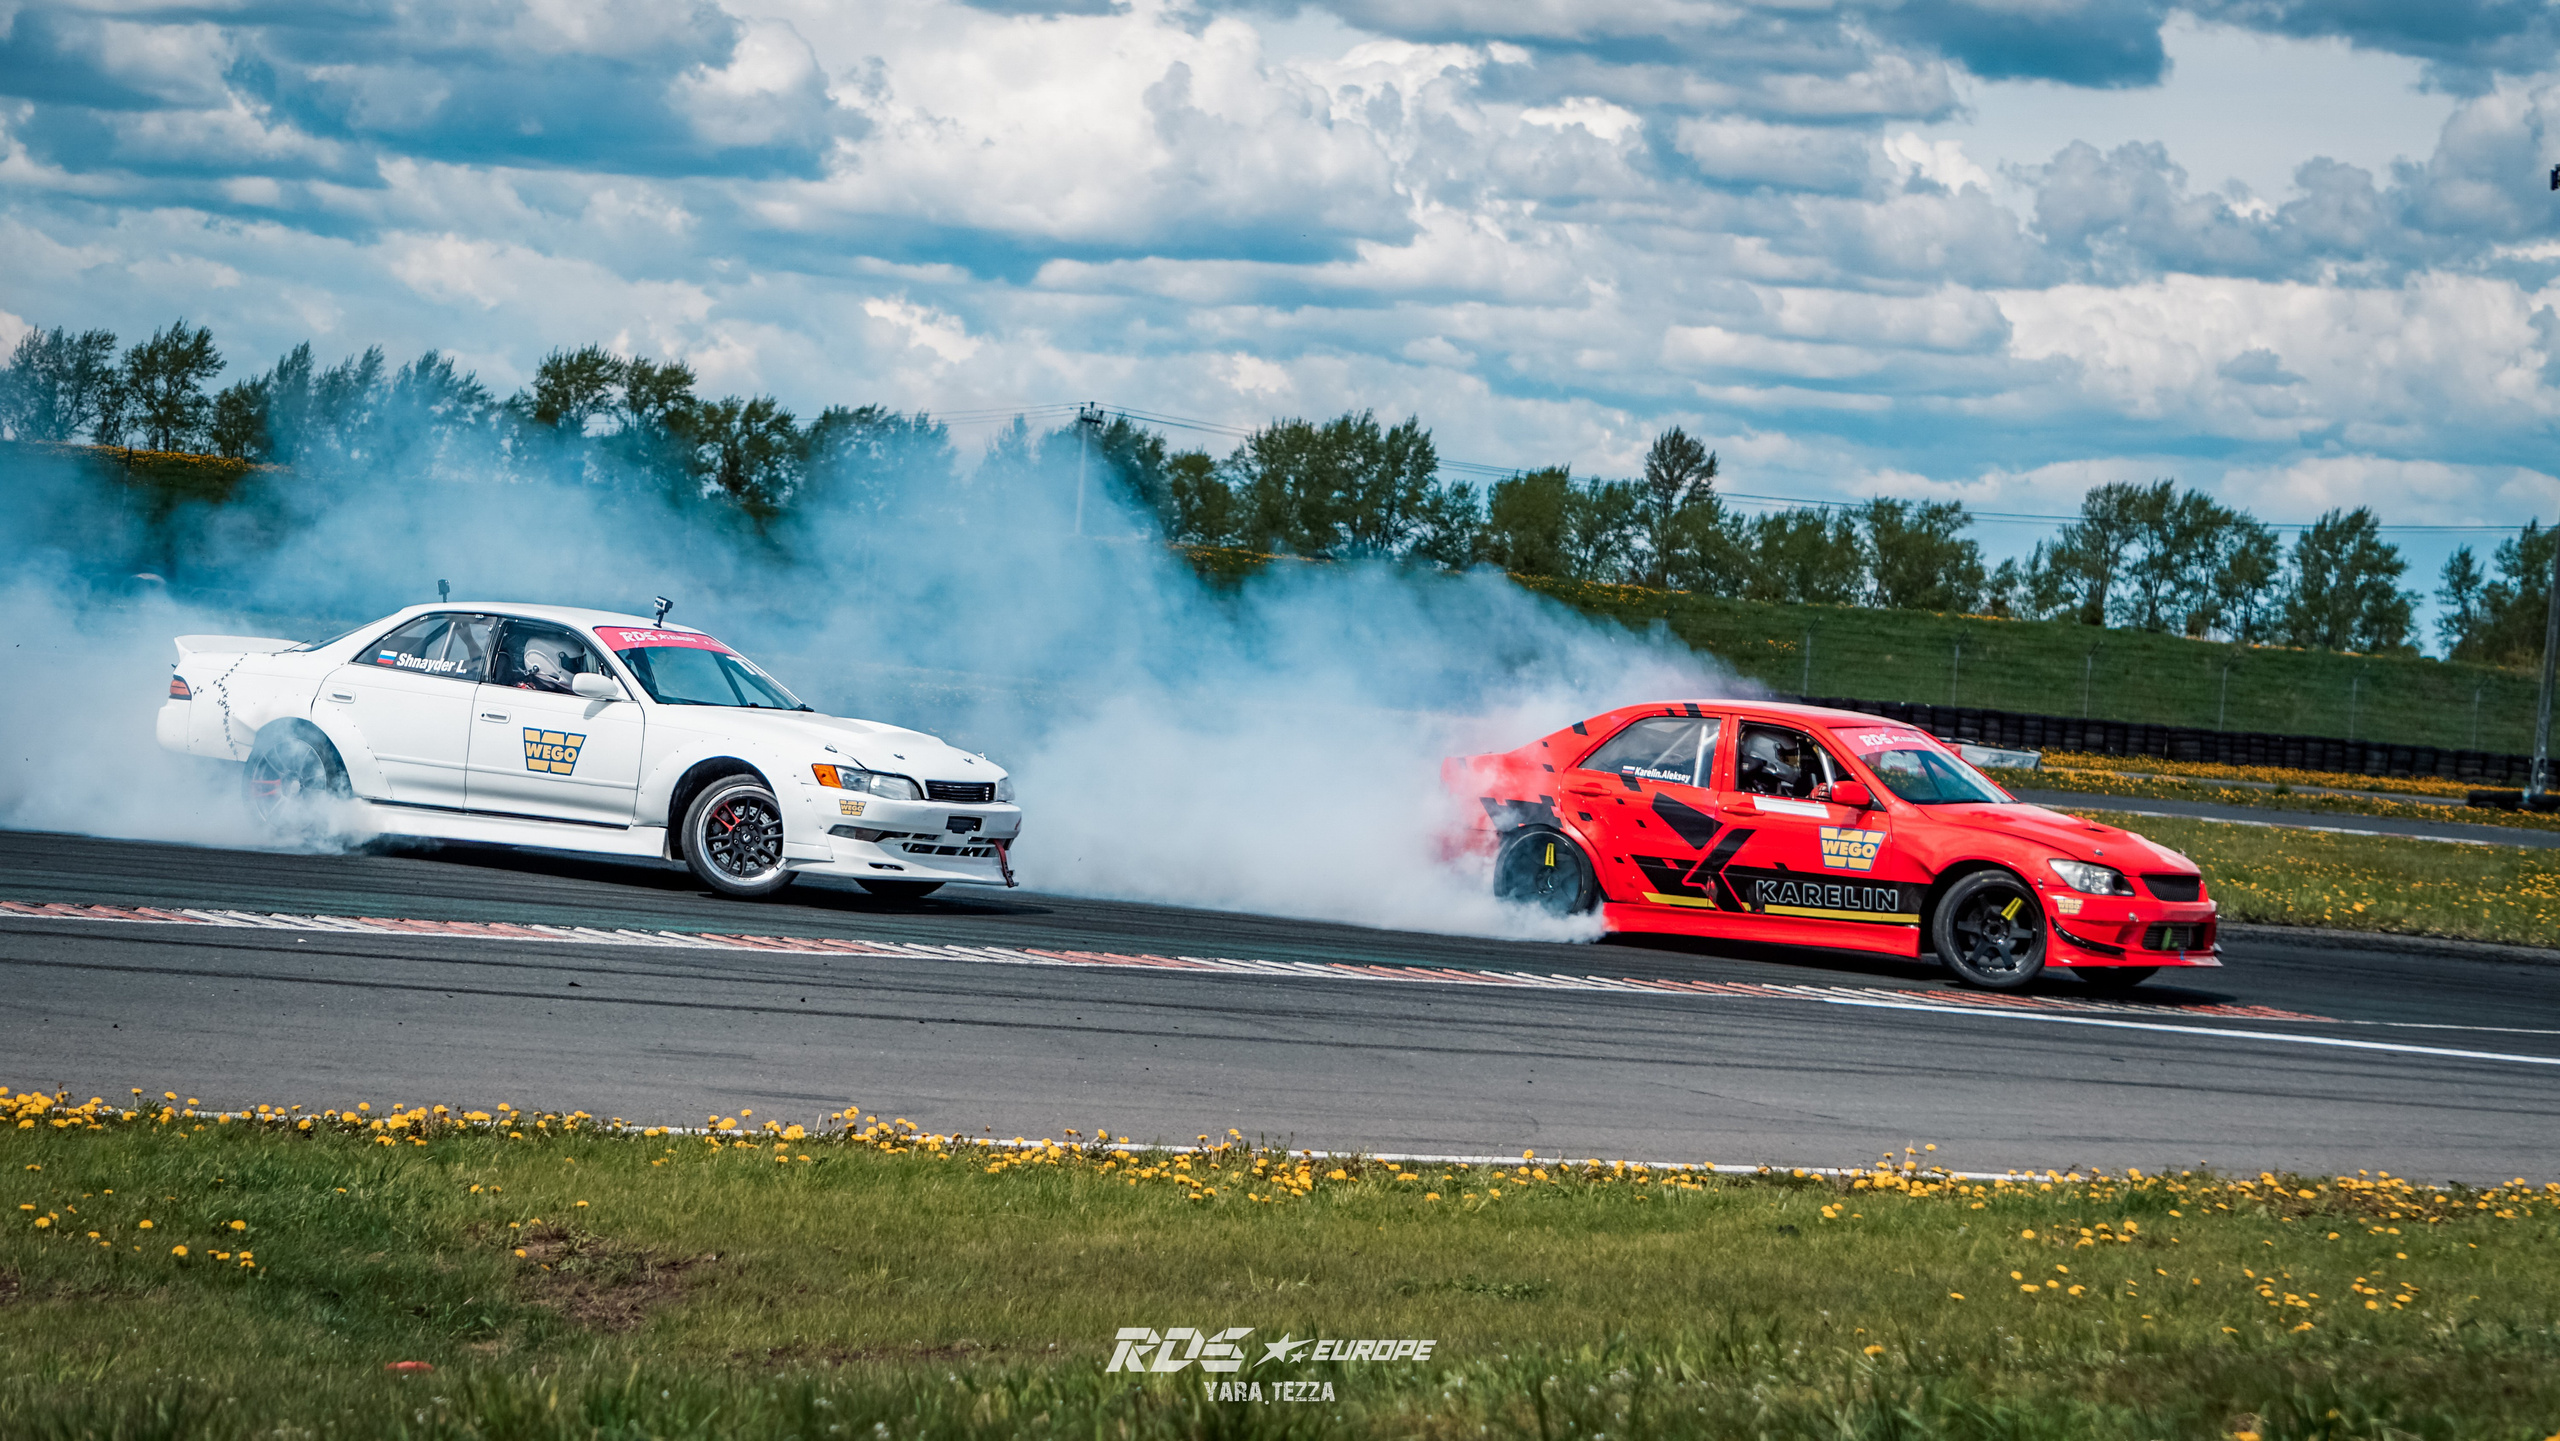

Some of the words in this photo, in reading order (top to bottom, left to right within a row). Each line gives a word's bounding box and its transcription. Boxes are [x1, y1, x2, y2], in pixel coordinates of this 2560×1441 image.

[619, 631, 658, 642] RDS
[396, 653, 455, 673] Shnayder
[456, 660, 467, 674] L.
[1859, 733, 1894, 746] RDS
[525, 742, 577, 763] WEGO
[1821, 840, 1876, 858] WEGO
[1756, 880, 1899, 912] KARELIN
